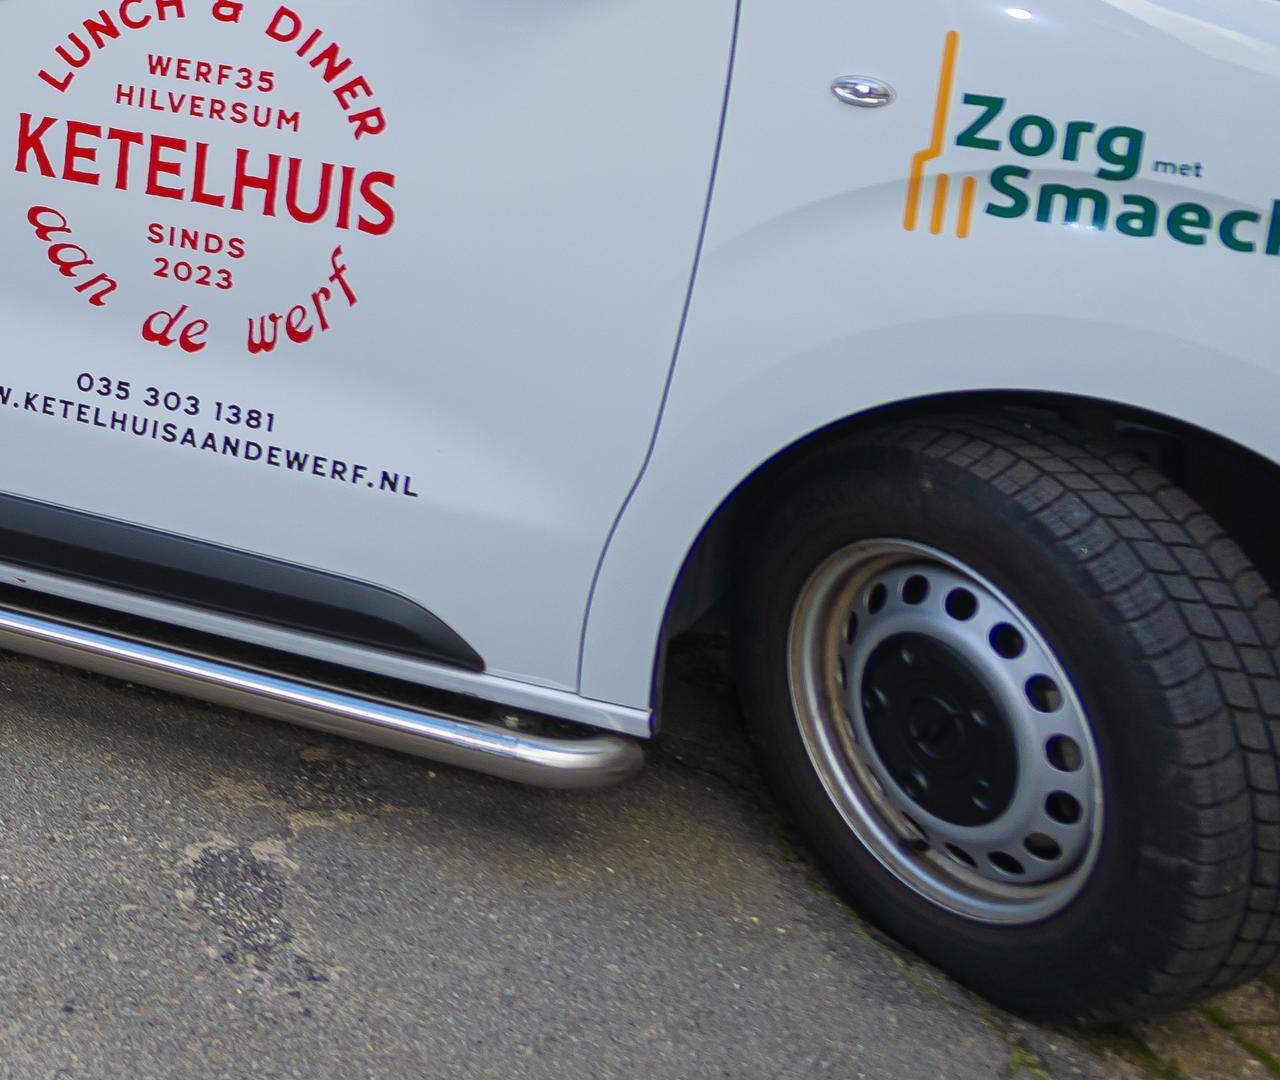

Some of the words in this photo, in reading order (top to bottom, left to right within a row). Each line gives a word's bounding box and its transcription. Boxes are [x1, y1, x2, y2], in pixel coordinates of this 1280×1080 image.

[147, 53, 276, 93] WERF35
[265, 5, 387, 140] DINER
[115, 83, 301, 133] HILVERSUM
[955, 92, 1146, 181] Zorg
[1152, 159, 1204, 179] met
[15, 112, 397, 237] KETELHUIS
[146, 222, 246, 259] SINDS
[26, 204, 119, 307] aan
[141, 303, 210, 354] de
[246, 244, 359, 354] werf
[152, 256, 234, 291] 2023
[76, 372, 132, 401] 035
[143, 386, 201, 417] 303
[214, 401, 276, 434] 1381
